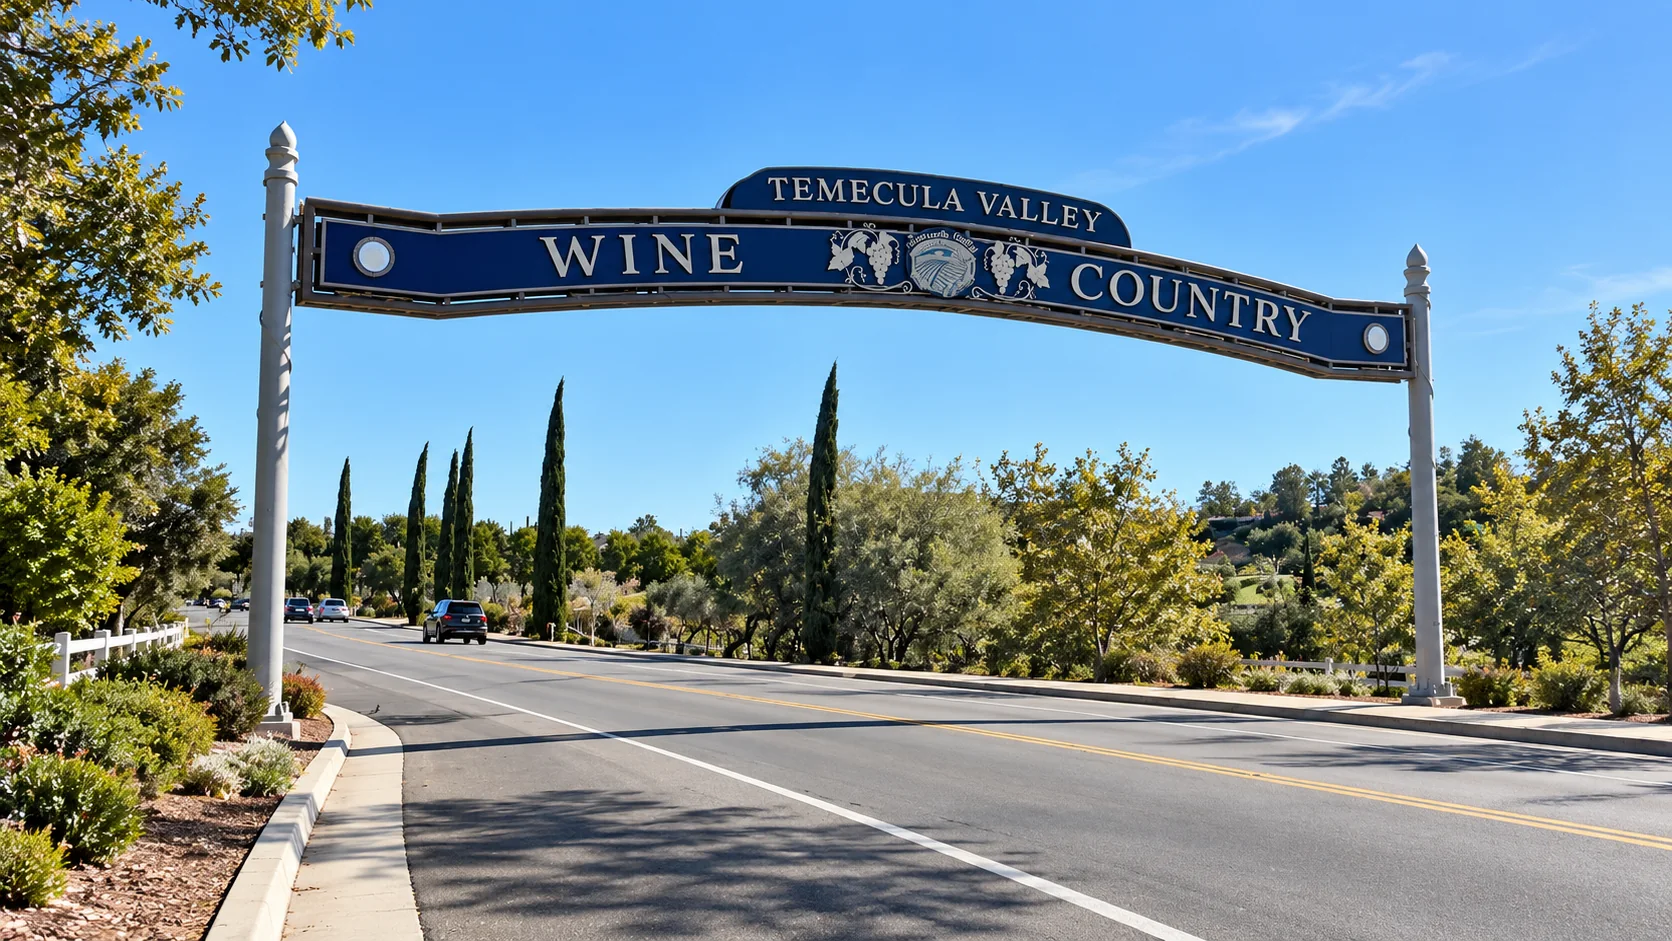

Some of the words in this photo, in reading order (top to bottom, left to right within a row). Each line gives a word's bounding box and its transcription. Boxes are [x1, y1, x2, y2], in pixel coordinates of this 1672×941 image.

[767, 176, 965, 212] TEMECULA
[976, 190, 1102, 233] VALLEY
[539, 233, 744, 278] WINE
[1070, 263, 1312, 343] COUNTRY
